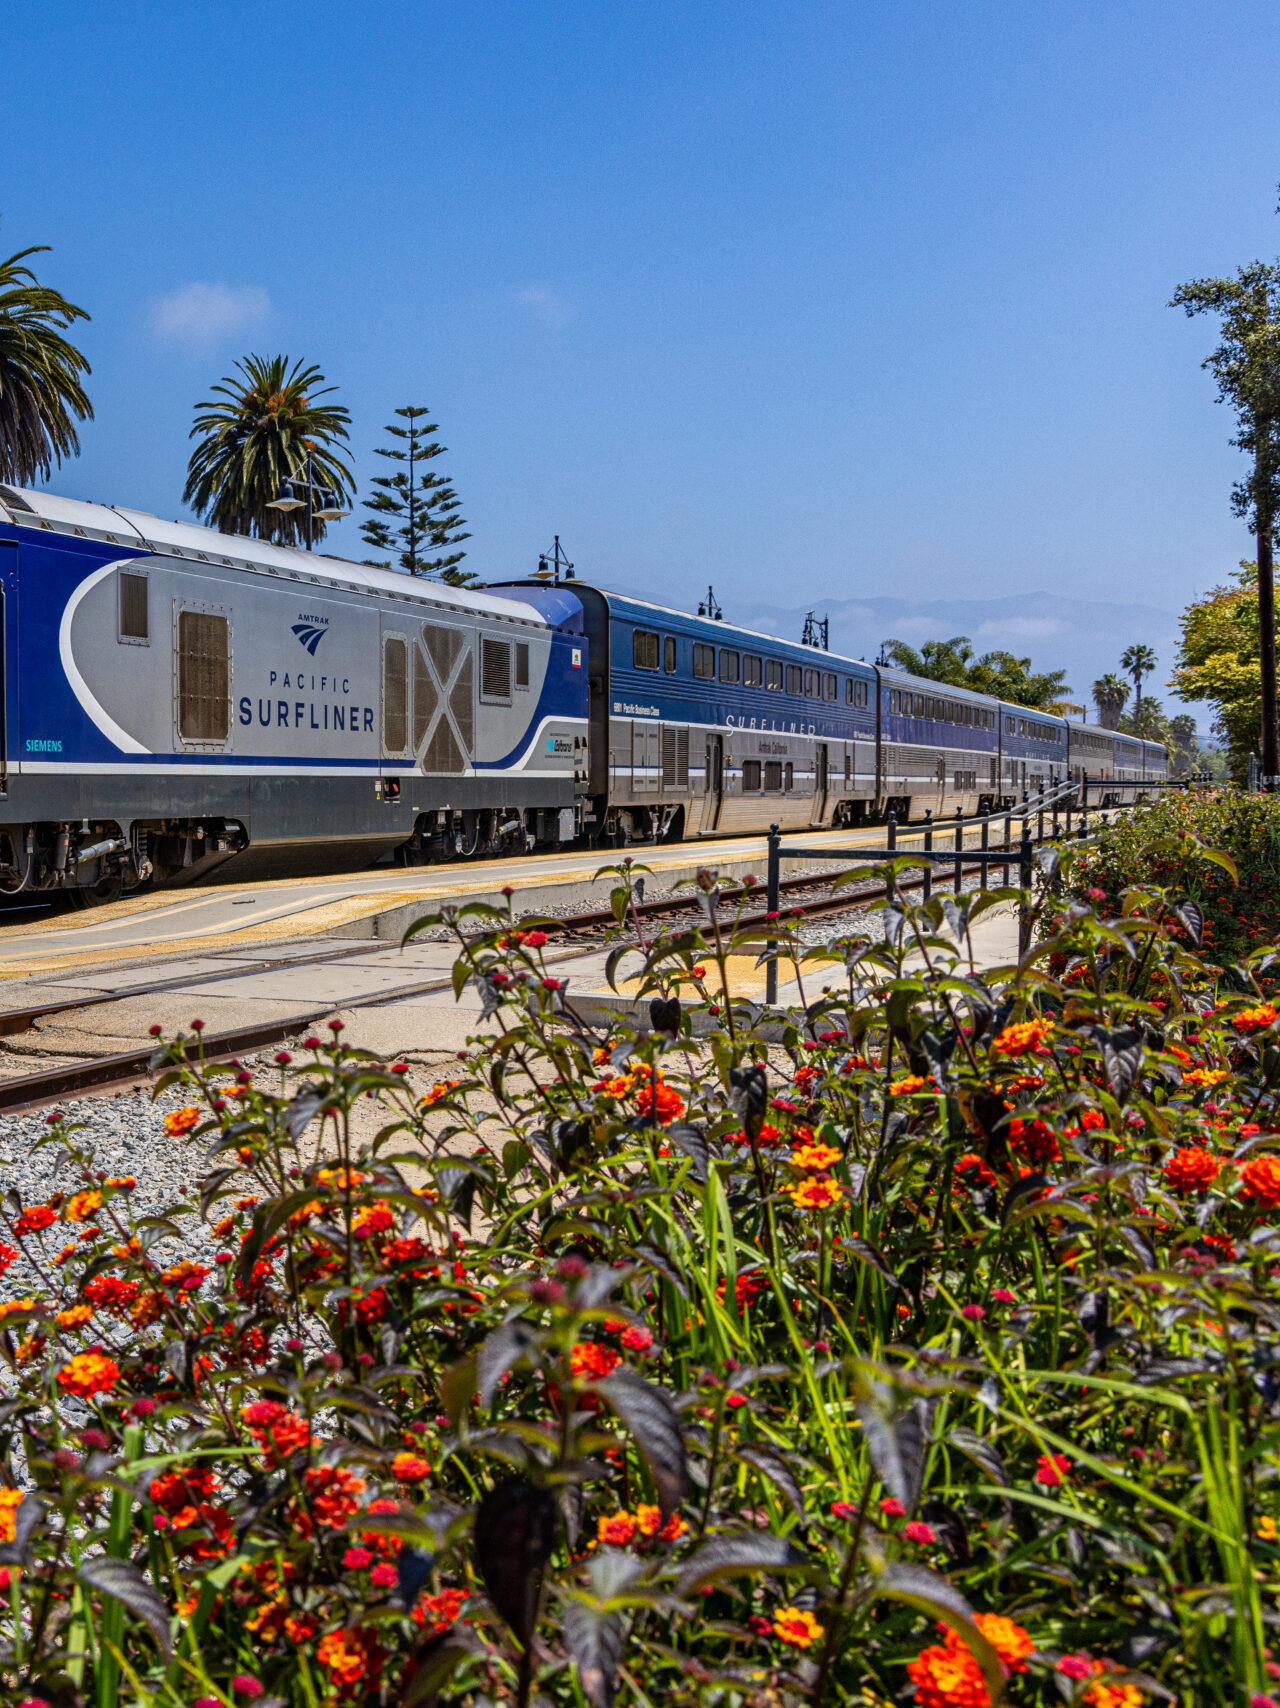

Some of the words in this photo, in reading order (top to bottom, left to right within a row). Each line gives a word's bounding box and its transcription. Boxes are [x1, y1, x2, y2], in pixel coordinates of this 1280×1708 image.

[298, 613, 329, 625] AMTRAK
[270, 671, 350, 694] PACIFIC
[239, 697, 374, 733] SURFLINER
[726, 715, 816, 743] SURFLINER
[25, 739, 63, 752] SIEMENS
